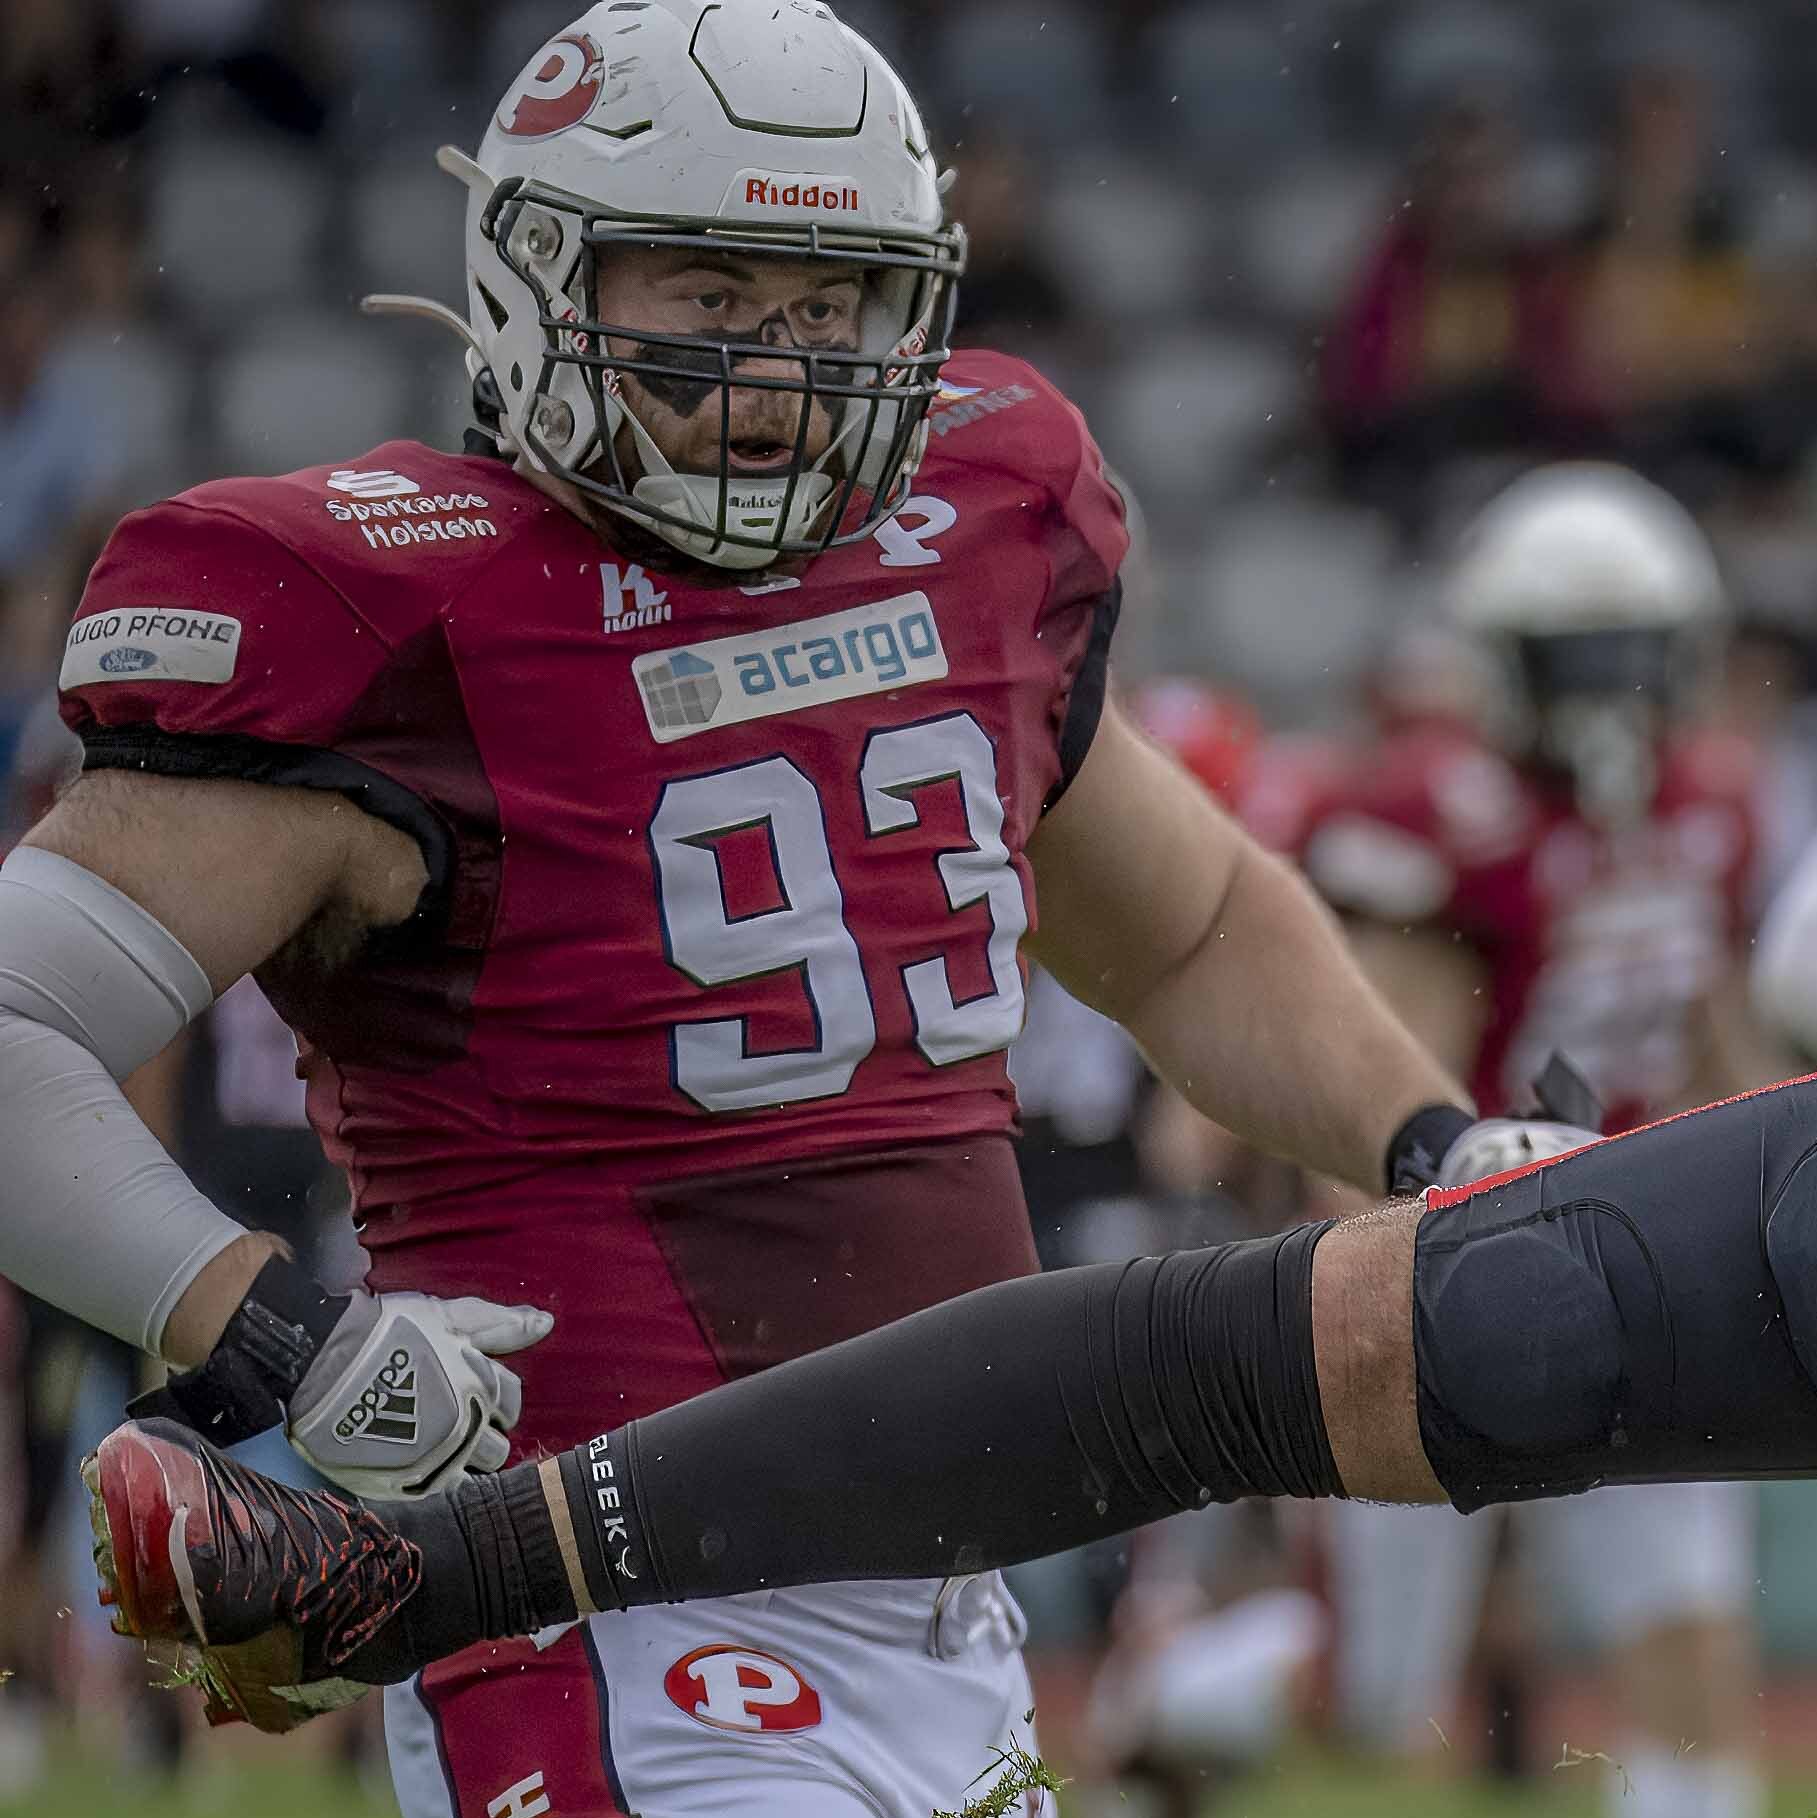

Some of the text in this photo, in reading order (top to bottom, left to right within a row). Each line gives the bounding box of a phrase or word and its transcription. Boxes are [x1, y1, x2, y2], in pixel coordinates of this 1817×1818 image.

[733, 612, 937, 696] acargo
[648, 708, 1027, 1114] 93
[686, 1651, 801, 1730] P
